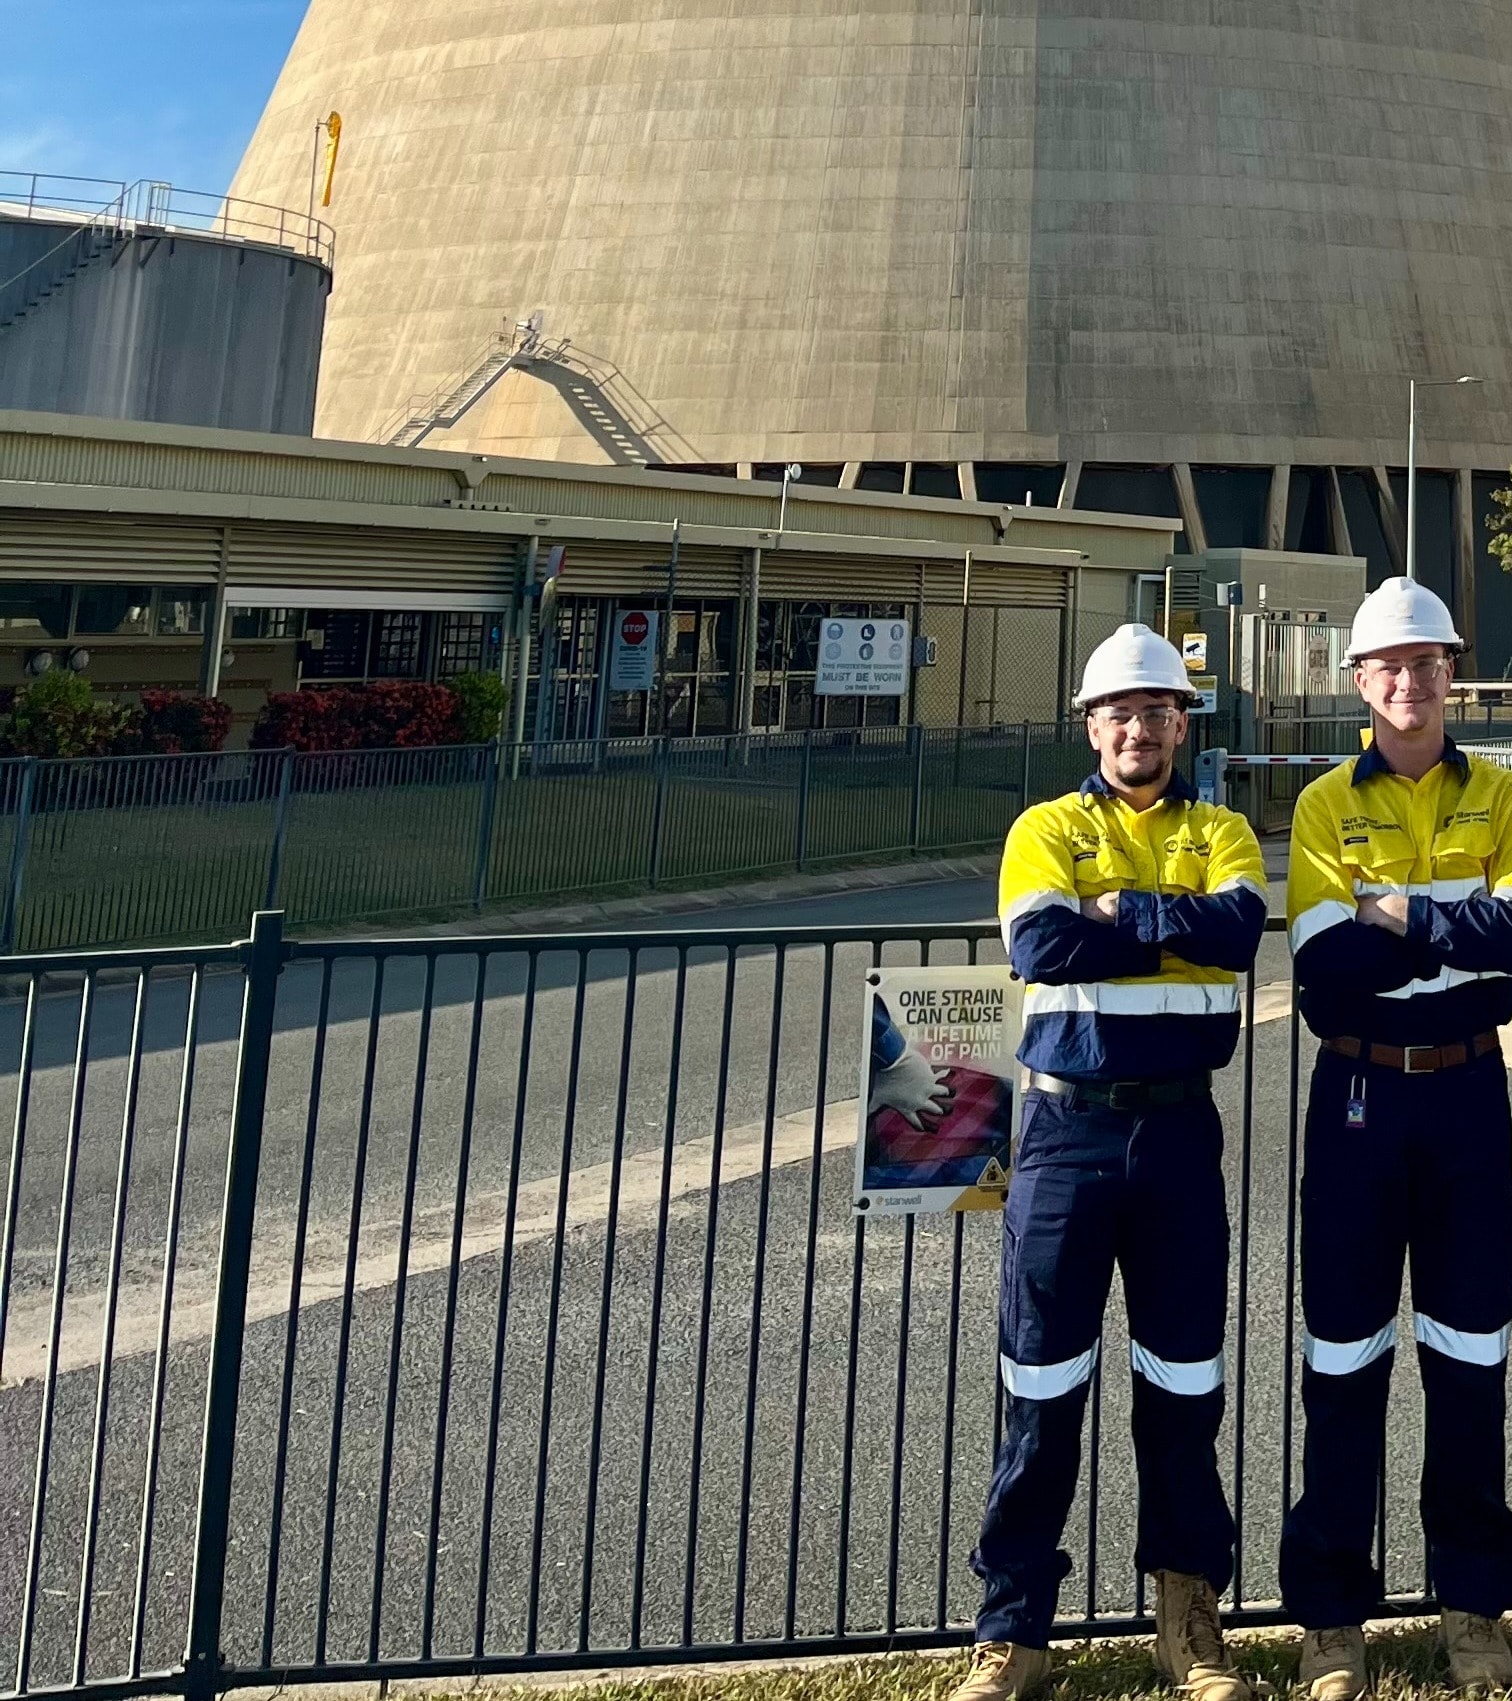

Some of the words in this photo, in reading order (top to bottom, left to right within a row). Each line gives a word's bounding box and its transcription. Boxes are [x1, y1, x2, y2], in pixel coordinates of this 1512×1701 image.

[623, 624, 647, 633] STOP
[822, 672, 851, 682] MUST
[856, 672, 869, 682] BE
[874, 672, 902, 682] WORN
[899, 990, 937, 1007] ONE
[941, 988, 1003, 1006] STRAIN
[906, 1008, 942, 1025] CAN
[947, 1006, 1003, 1023] CAUSE
[908, 1026, 920, 1042] A
[924, 1024, 1002, 1042] LIFETIME
[931, 1043, 955, 1061] OF
[959, 1042, 1001, 1060] PAIN
